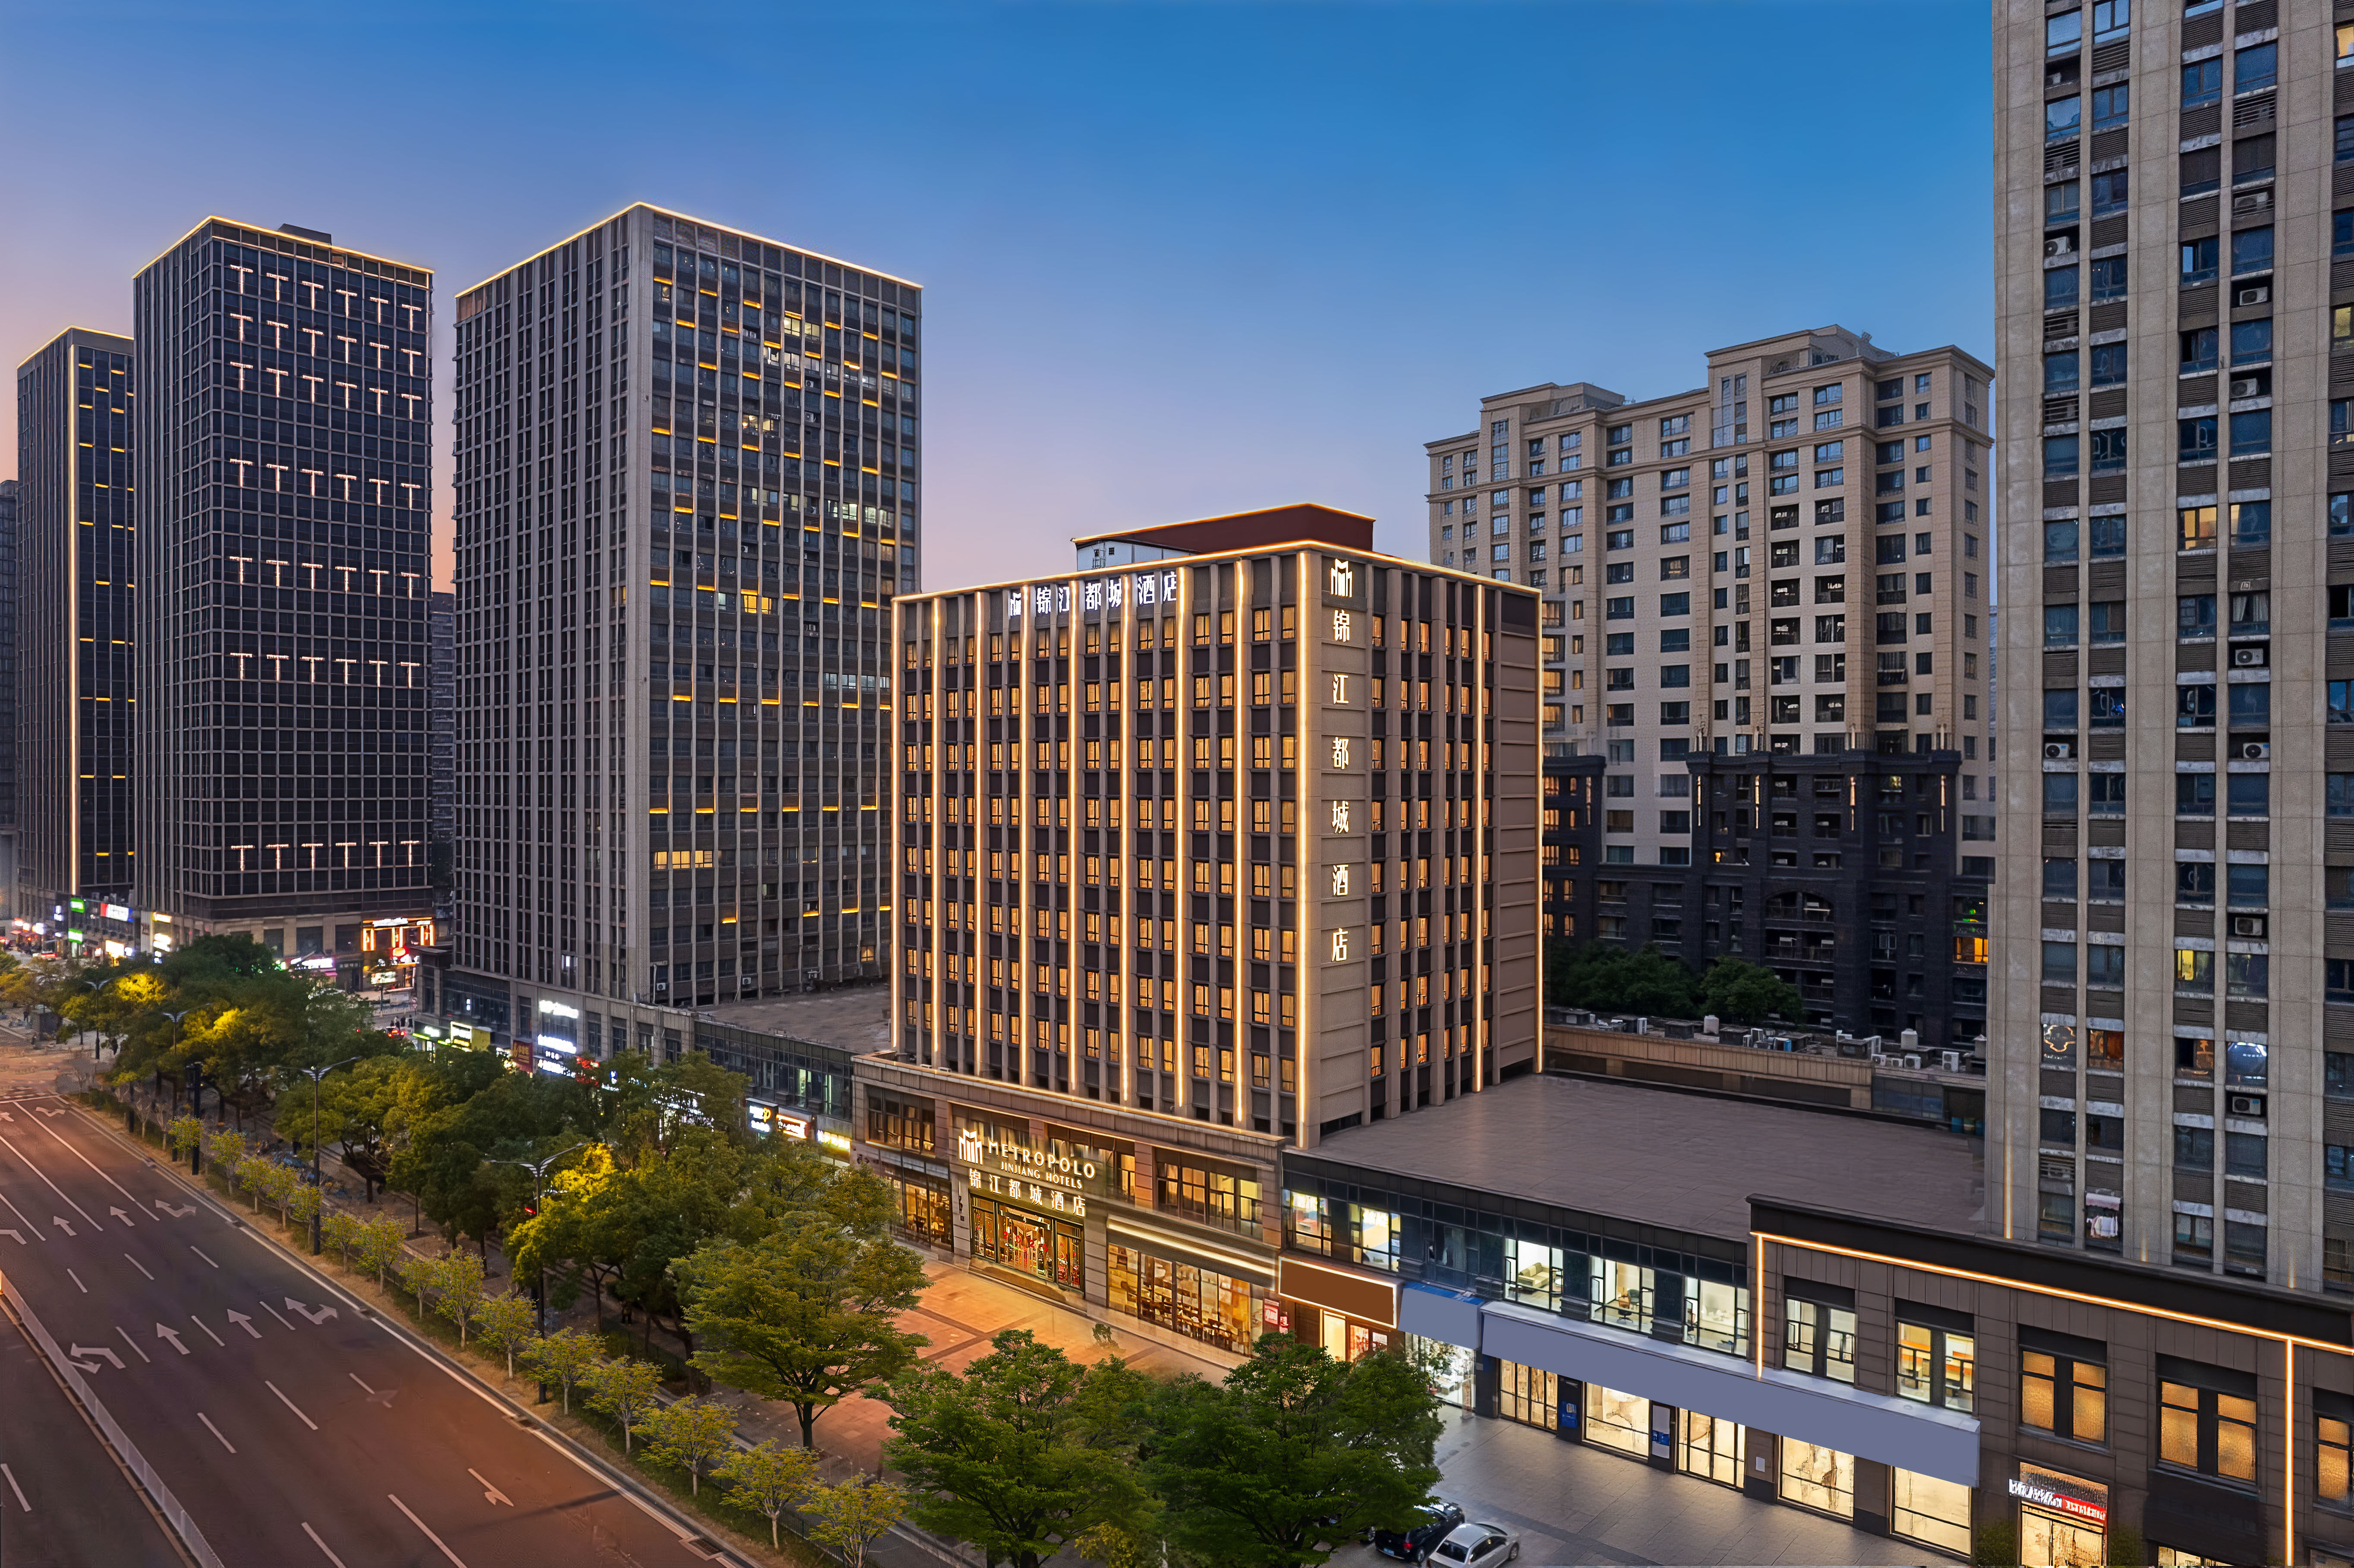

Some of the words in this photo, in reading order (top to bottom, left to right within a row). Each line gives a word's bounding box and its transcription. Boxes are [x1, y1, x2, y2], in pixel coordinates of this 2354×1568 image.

[1332, 610, 1350, 961] 锦江都城酒店
[989, 1140, 1095, 1178] METROPOLO
[1001, 1162, 1040, 1179] JINJIANG
[1046, 1173, 1082, 1189] HOTELS
[969, 1168, 1085, 1217] 锦江都城酒店
